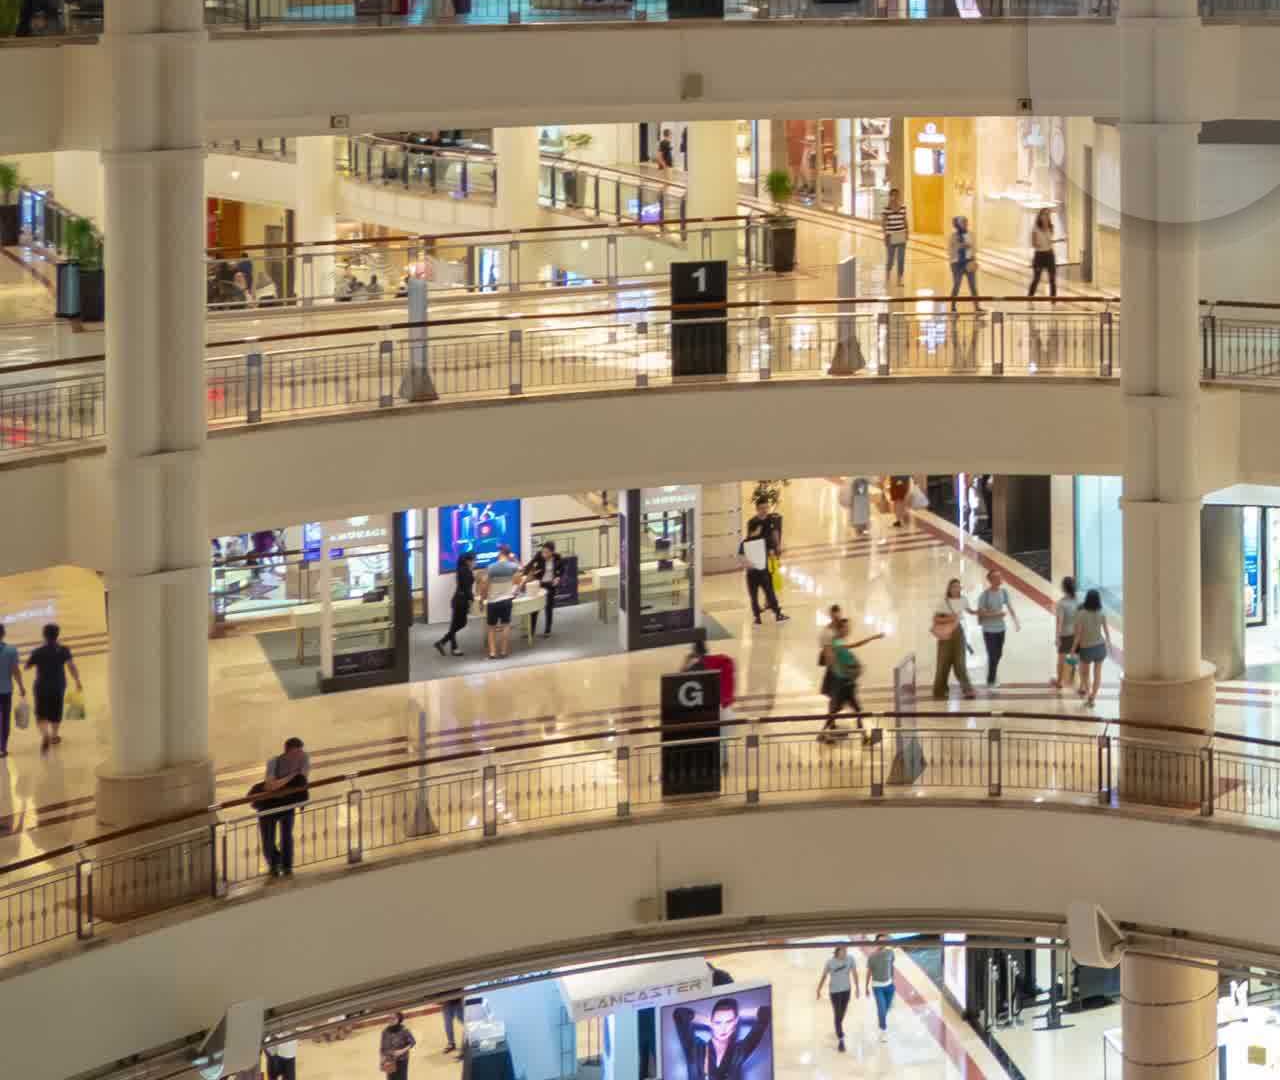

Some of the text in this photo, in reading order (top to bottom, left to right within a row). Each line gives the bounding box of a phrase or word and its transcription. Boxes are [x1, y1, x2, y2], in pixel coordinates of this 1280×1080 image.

[691, 266, 707, 293] 1
[678, 681, 704, 707] G
[583, 977, 702, 1012] LANCASTER
